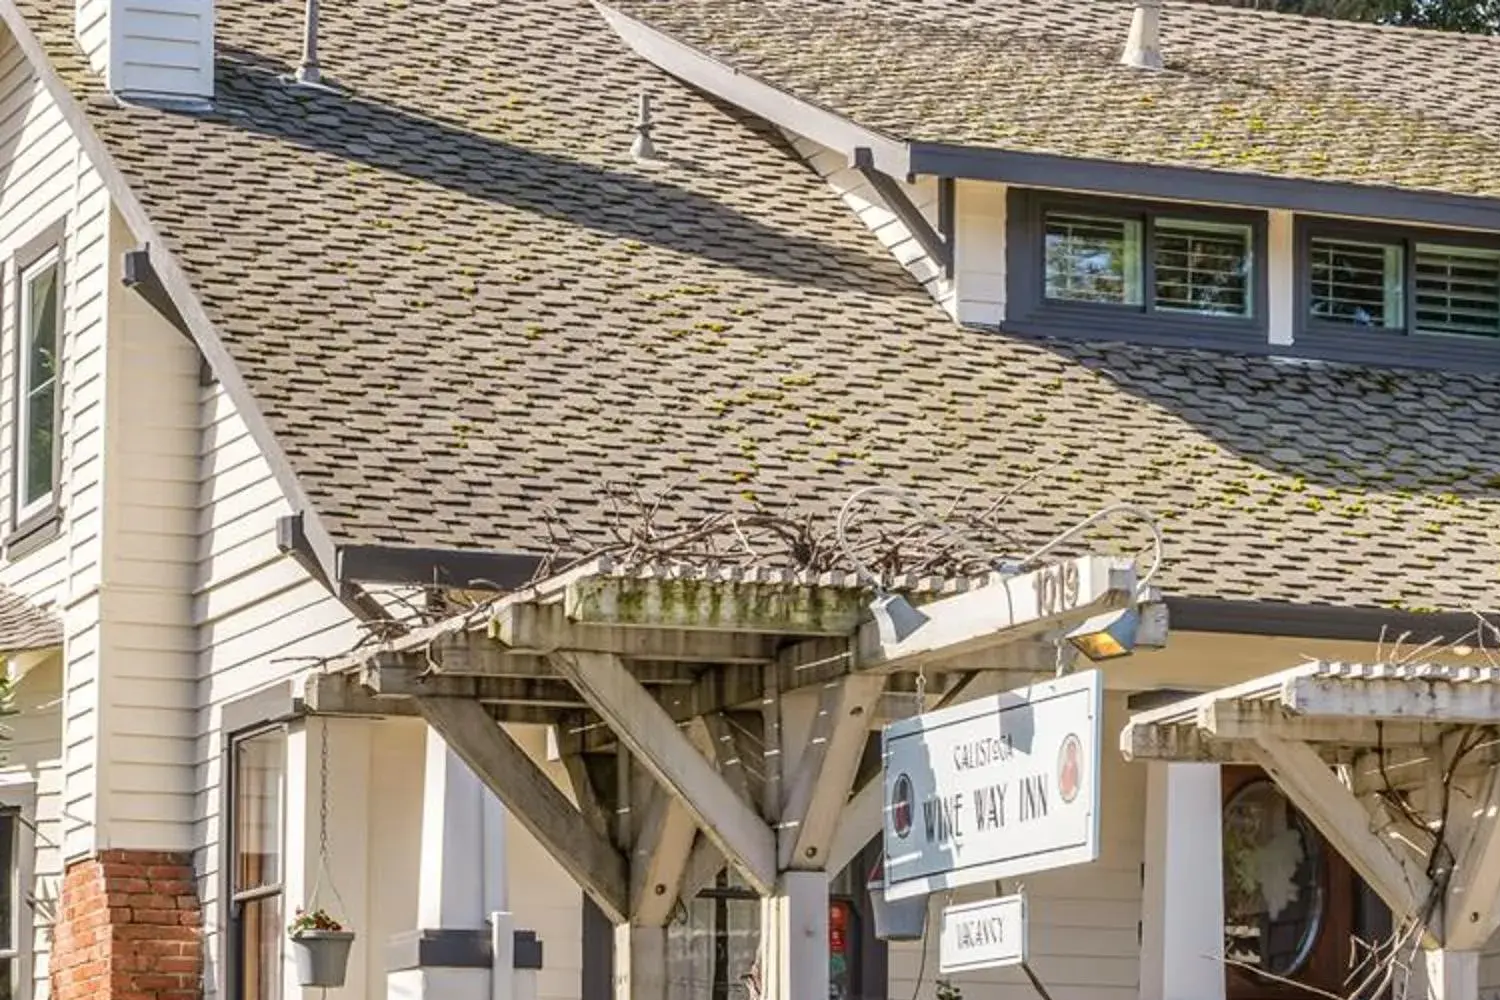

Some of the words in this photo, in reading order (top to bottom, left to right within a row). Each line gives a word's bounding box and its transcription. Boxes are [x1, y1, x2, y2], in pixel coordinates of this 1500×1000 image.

[1032, 560, 1080, 616] 1019
[954, 734, 1014, 771] CALISTOGA
[923, 793, 963, 843] WINE
[974, 783, 1008, 832] WAY
[1018, 773, 1049, 822] INN
